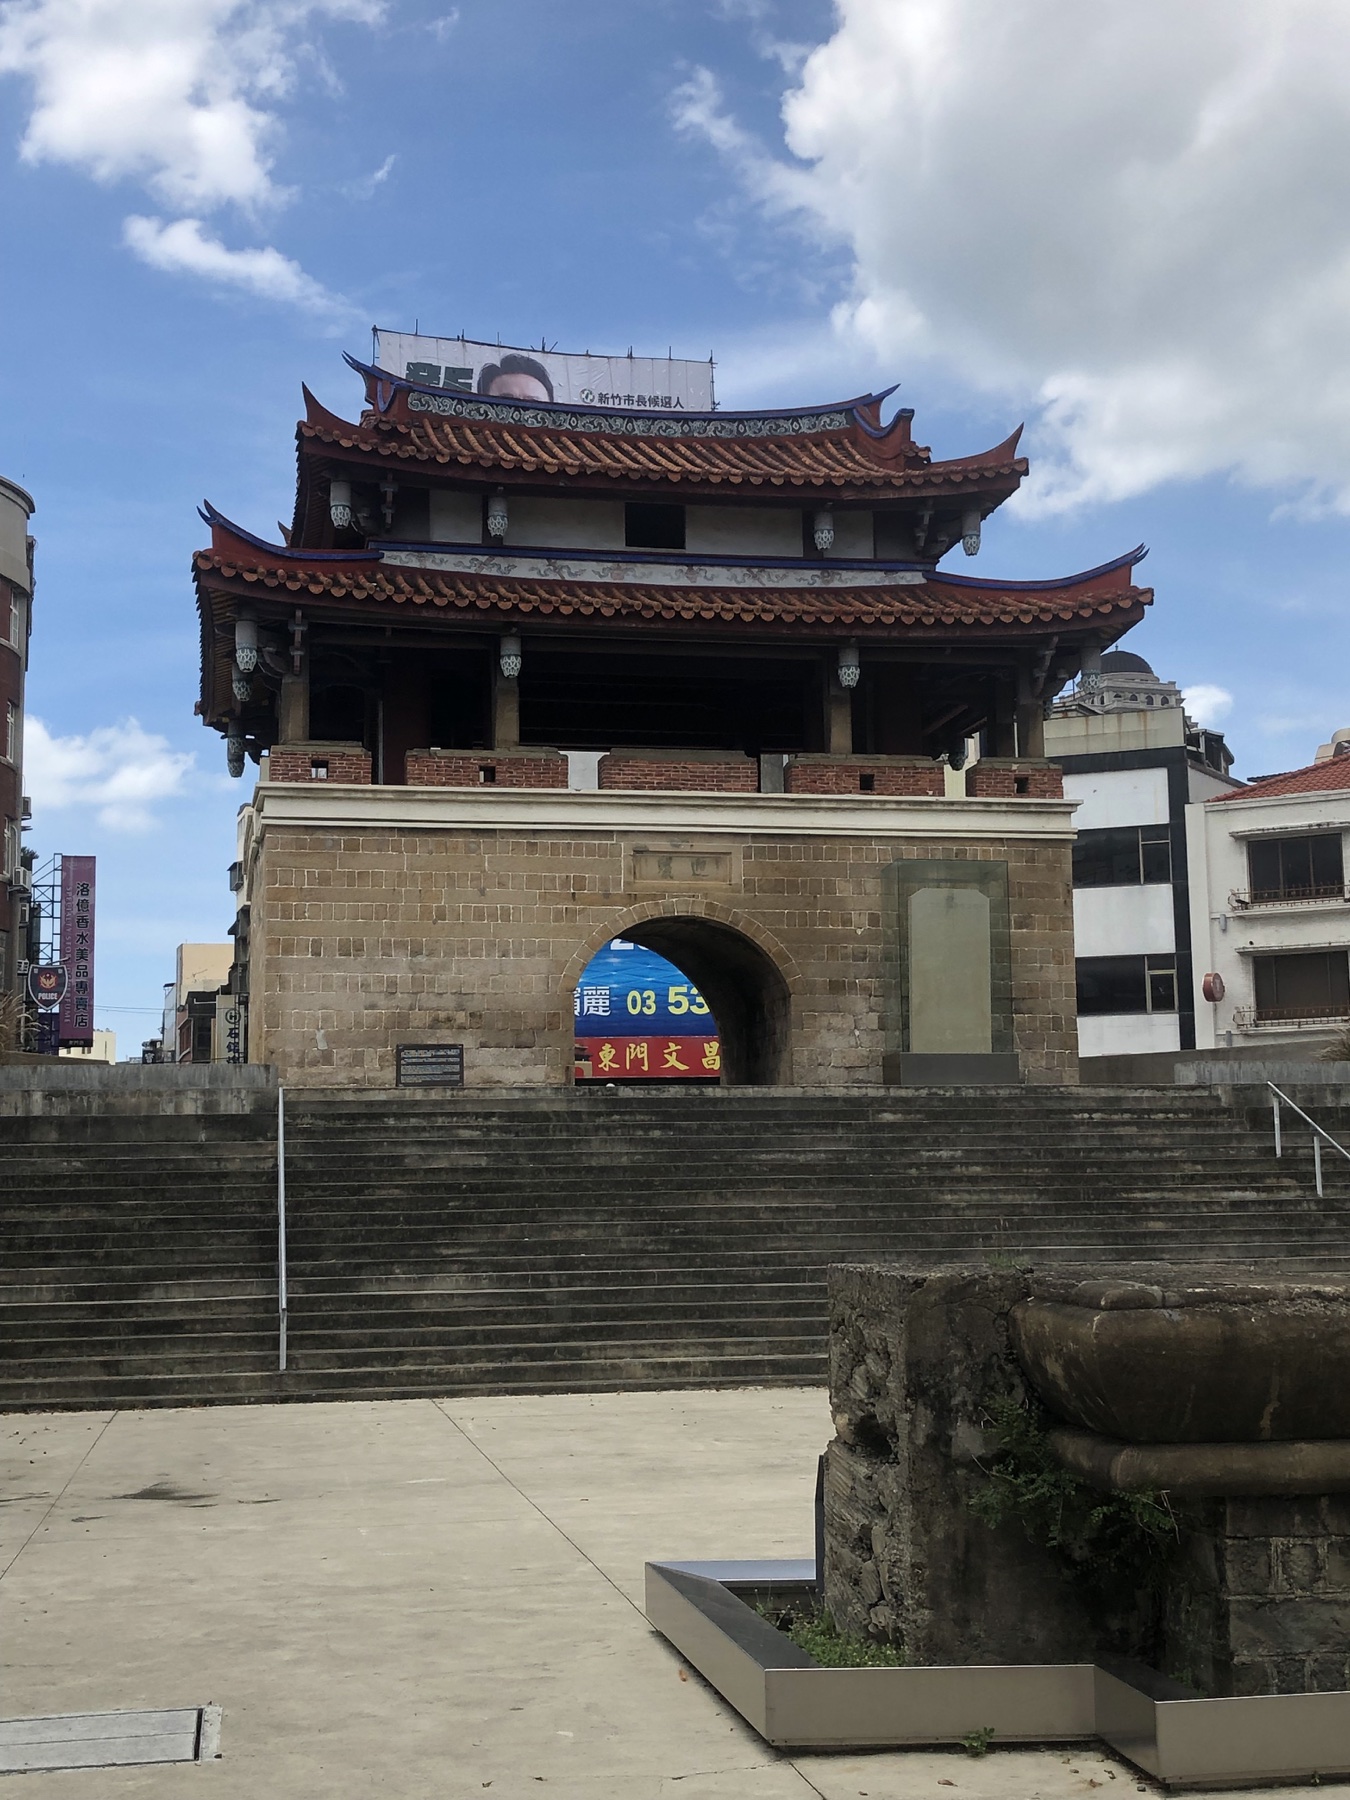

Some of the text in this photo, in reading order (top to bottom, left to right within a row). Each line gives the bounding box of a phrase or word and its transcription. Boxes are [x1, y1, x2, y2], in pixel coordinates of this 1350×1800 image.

[597, 391, 685, 409] 新竹市長候選人
[75, 882, 90, 1028] 洛億香水美品專賣店
[38, 992, 58, 1000] POLICE
[627, 990, 656, 1015] 03
